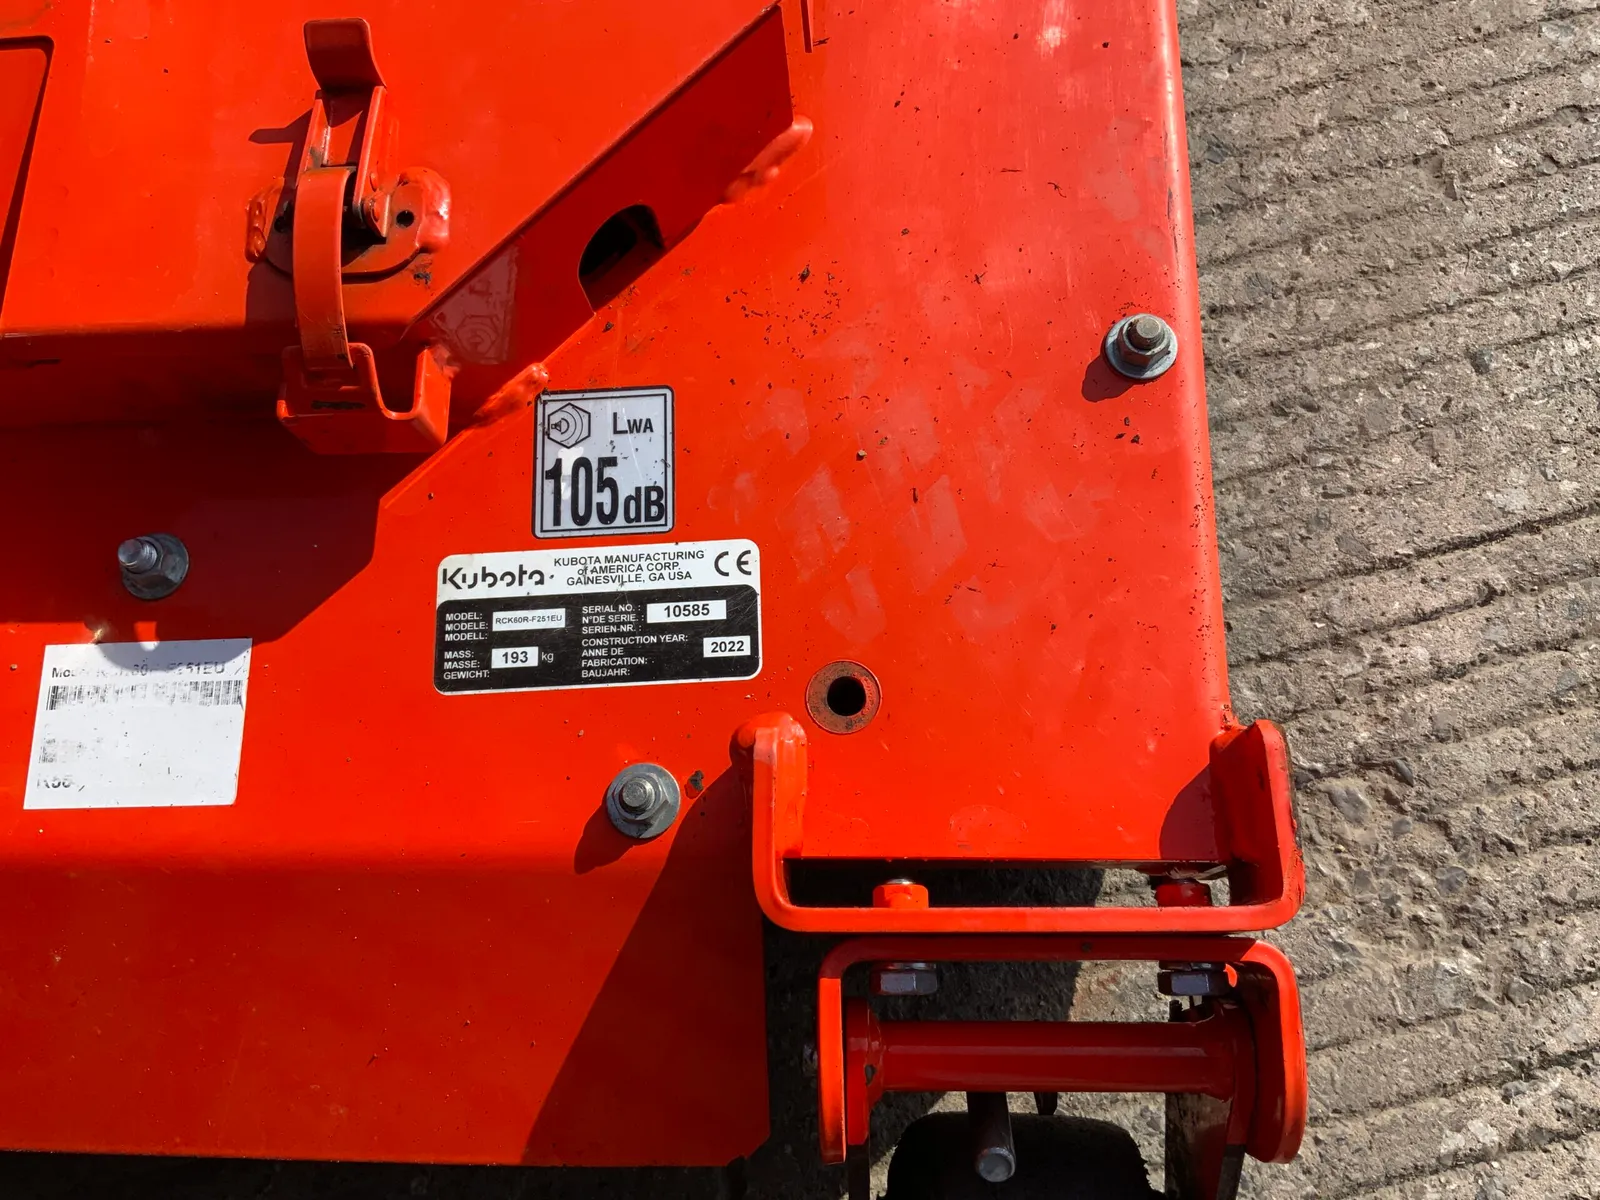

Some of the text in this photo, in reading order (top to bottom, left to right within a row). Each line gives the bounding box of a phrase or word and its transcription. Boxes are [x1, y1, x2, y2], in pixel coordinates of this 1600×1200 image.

[545, 456, 665, 526] 105 dB
[554, 550, 705, 566] KUBOTA MANUFACTURING
[577, 561, 681, 575] of AMERICA CORP.
[714, 550, 752, 577] CE
[442, 564, 545, 590] Kubota
[566, 571, 692, 586] GAINESVILLE, GA USA
[582, 604, 616, 614] SERIAL
[664, 603, 710, 618] 10585
[445, 612, 483, 621] MODEL:
[495, 615, 563, 625] RCK60R-F251EU
[445, 622, 488, 631] MODELE:
[445, 632, 488, 641] MODELL:
[581, 634, 688, 647] CONSTRUCTION YEAR:
[711, 640, 745, 653] 2022
[444, 650, 474, 659] MASS:
[581, 647, 624, 657] ANNE DE
[502, 651, 529, 664] 193
[541, 652, 554, 663] kg
[581, 657, 648, 667] FABRICATION:
[443, 660, 481, 669] MASSE:
[443, 670, 490, 680] GEWICHT:
[581, 668, 631, 678] BAUJAHR:
